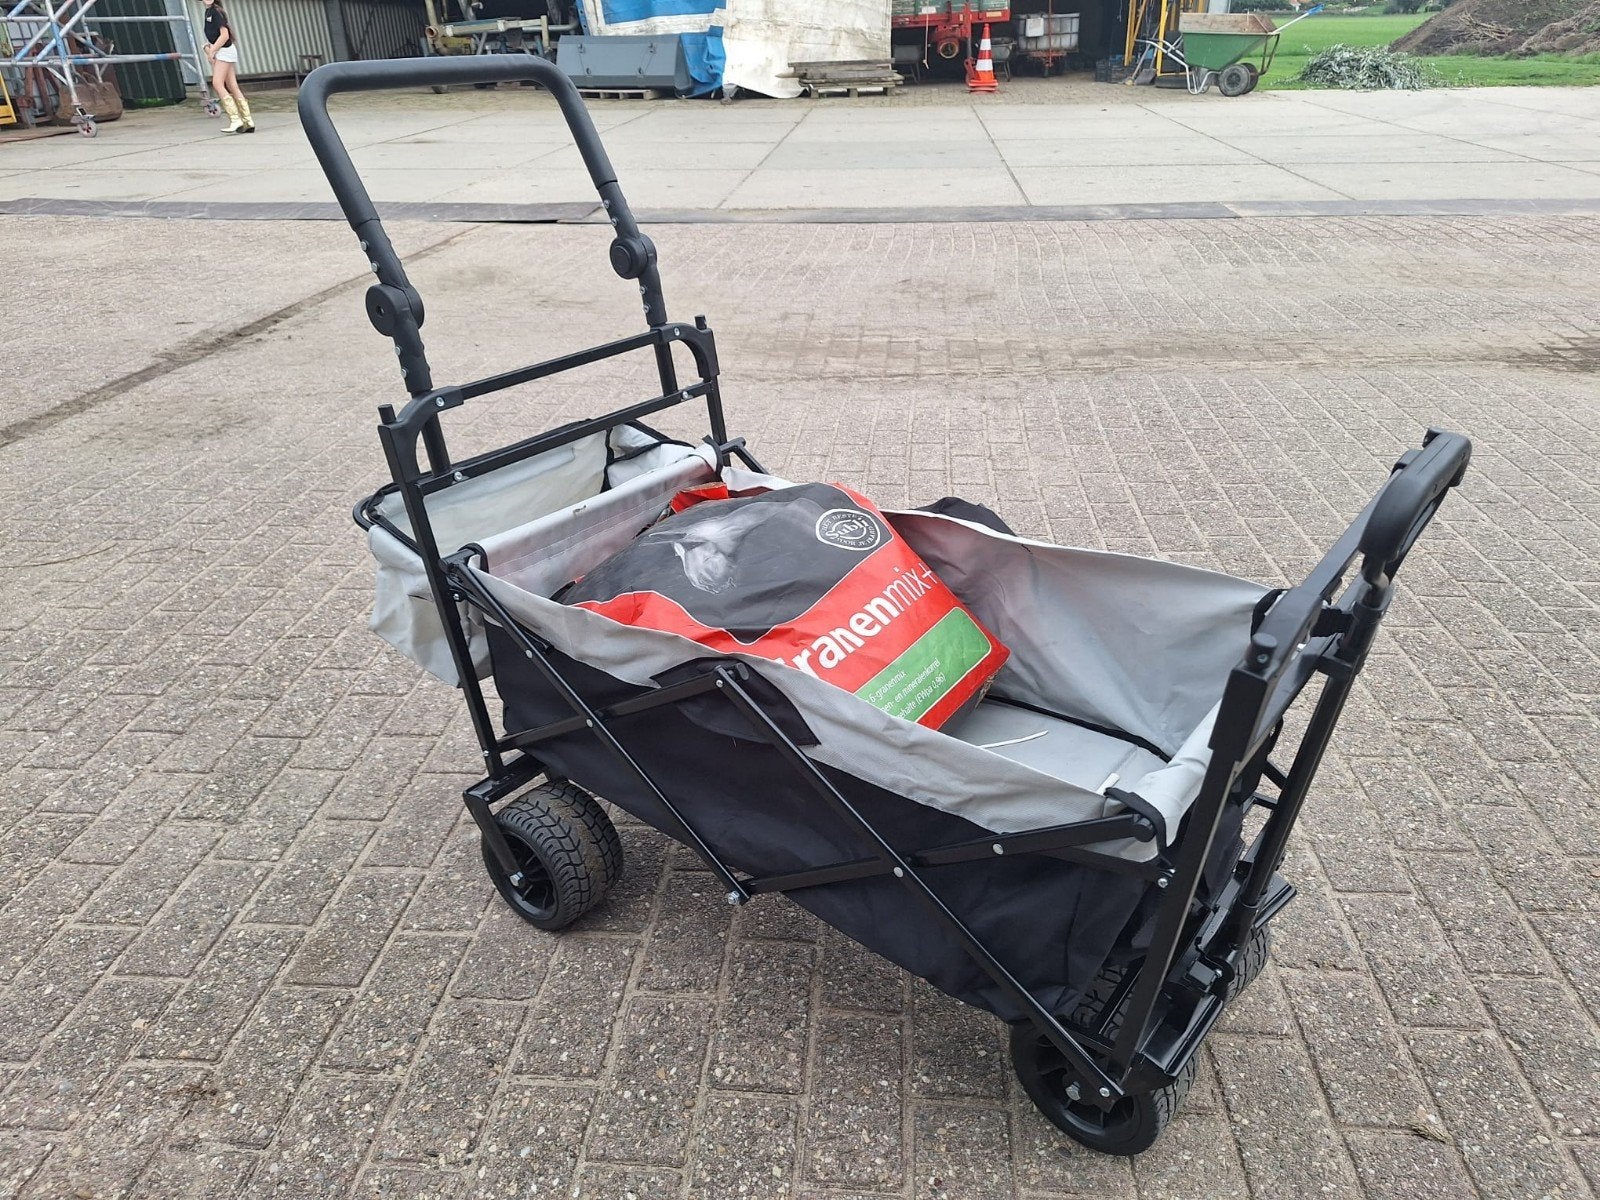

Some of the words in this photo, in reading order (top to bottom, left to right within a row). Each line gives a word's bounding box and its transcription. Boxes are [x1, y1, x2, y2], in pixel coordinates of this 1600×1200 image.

[825, 517, 869, 539] Subli
[775, 562, 938, 679] ranenmix+
[894, 692, 904, 703] en
[902, 657, 941, 697] mineralenkorrel
